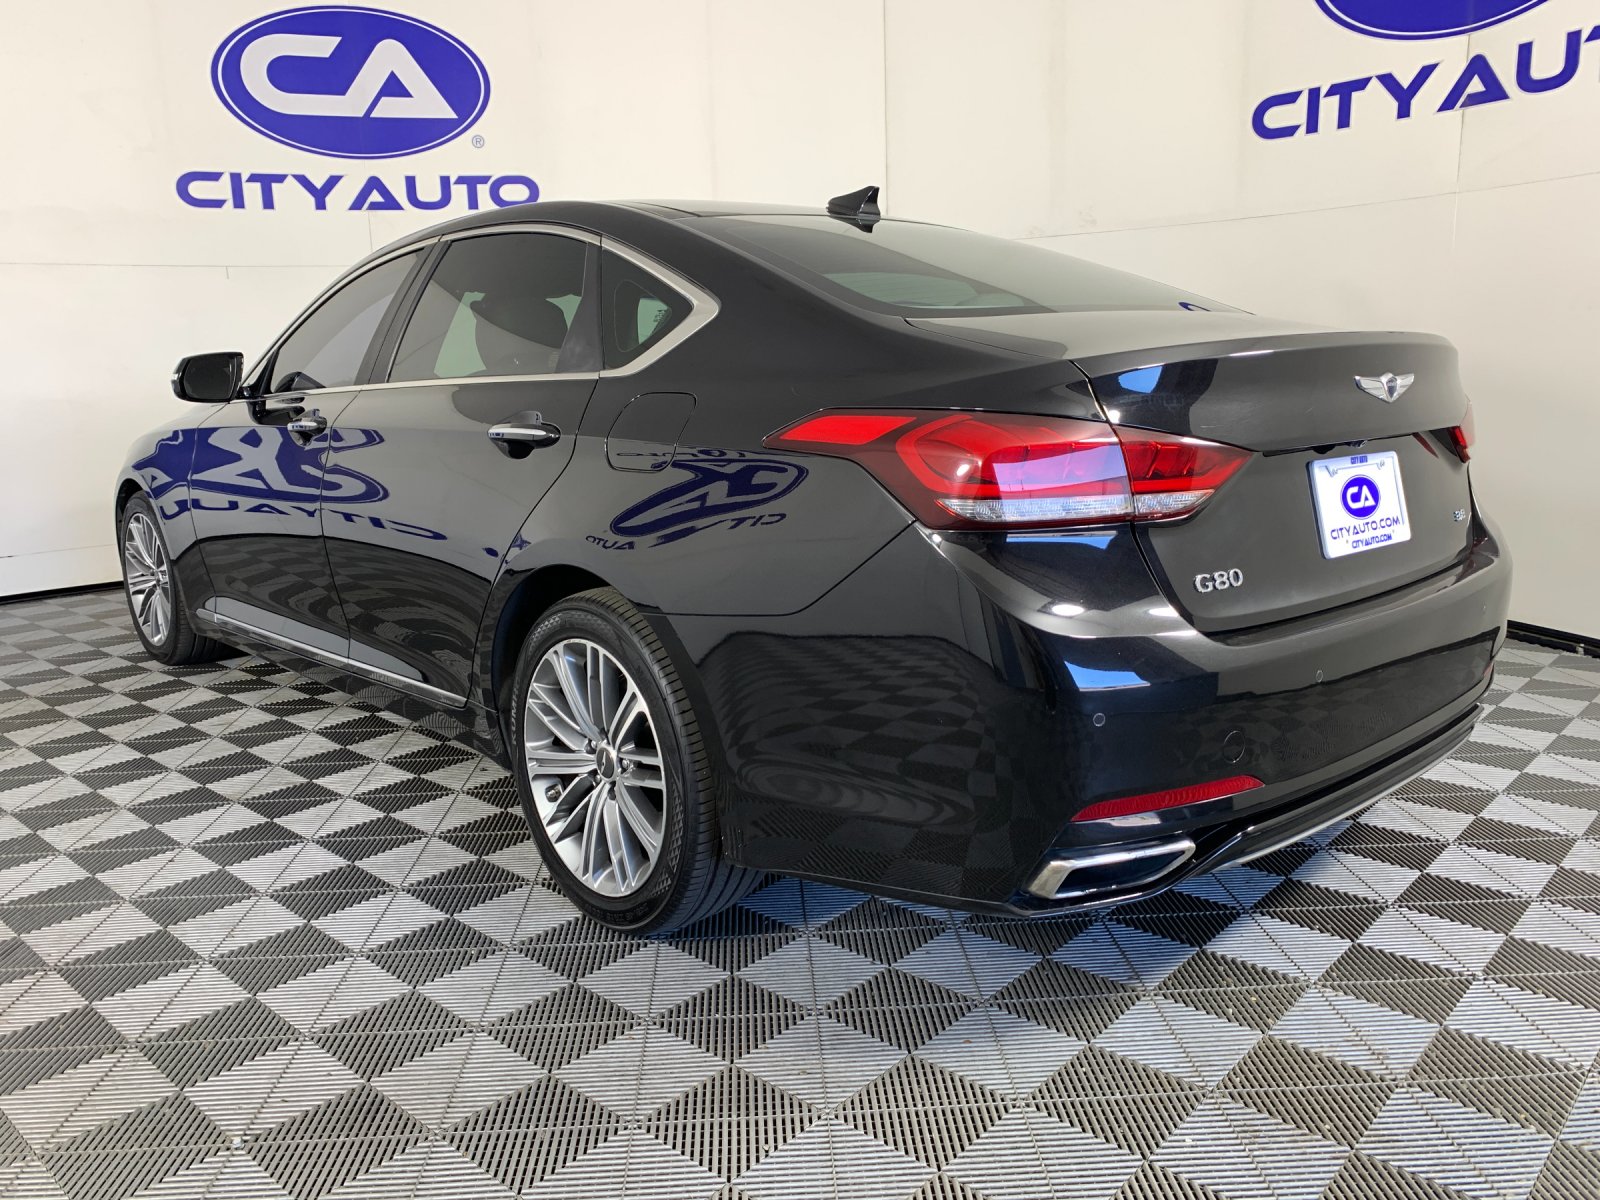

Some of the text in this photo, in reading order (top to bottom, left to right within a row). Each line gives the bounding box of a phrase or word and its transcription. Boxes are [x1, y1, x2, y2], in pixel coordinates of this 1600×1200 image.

[239, 33, 459, 119] CA
[1346, 484, 1376, 510] CA
[1193, 568, 1244, 593] G80
